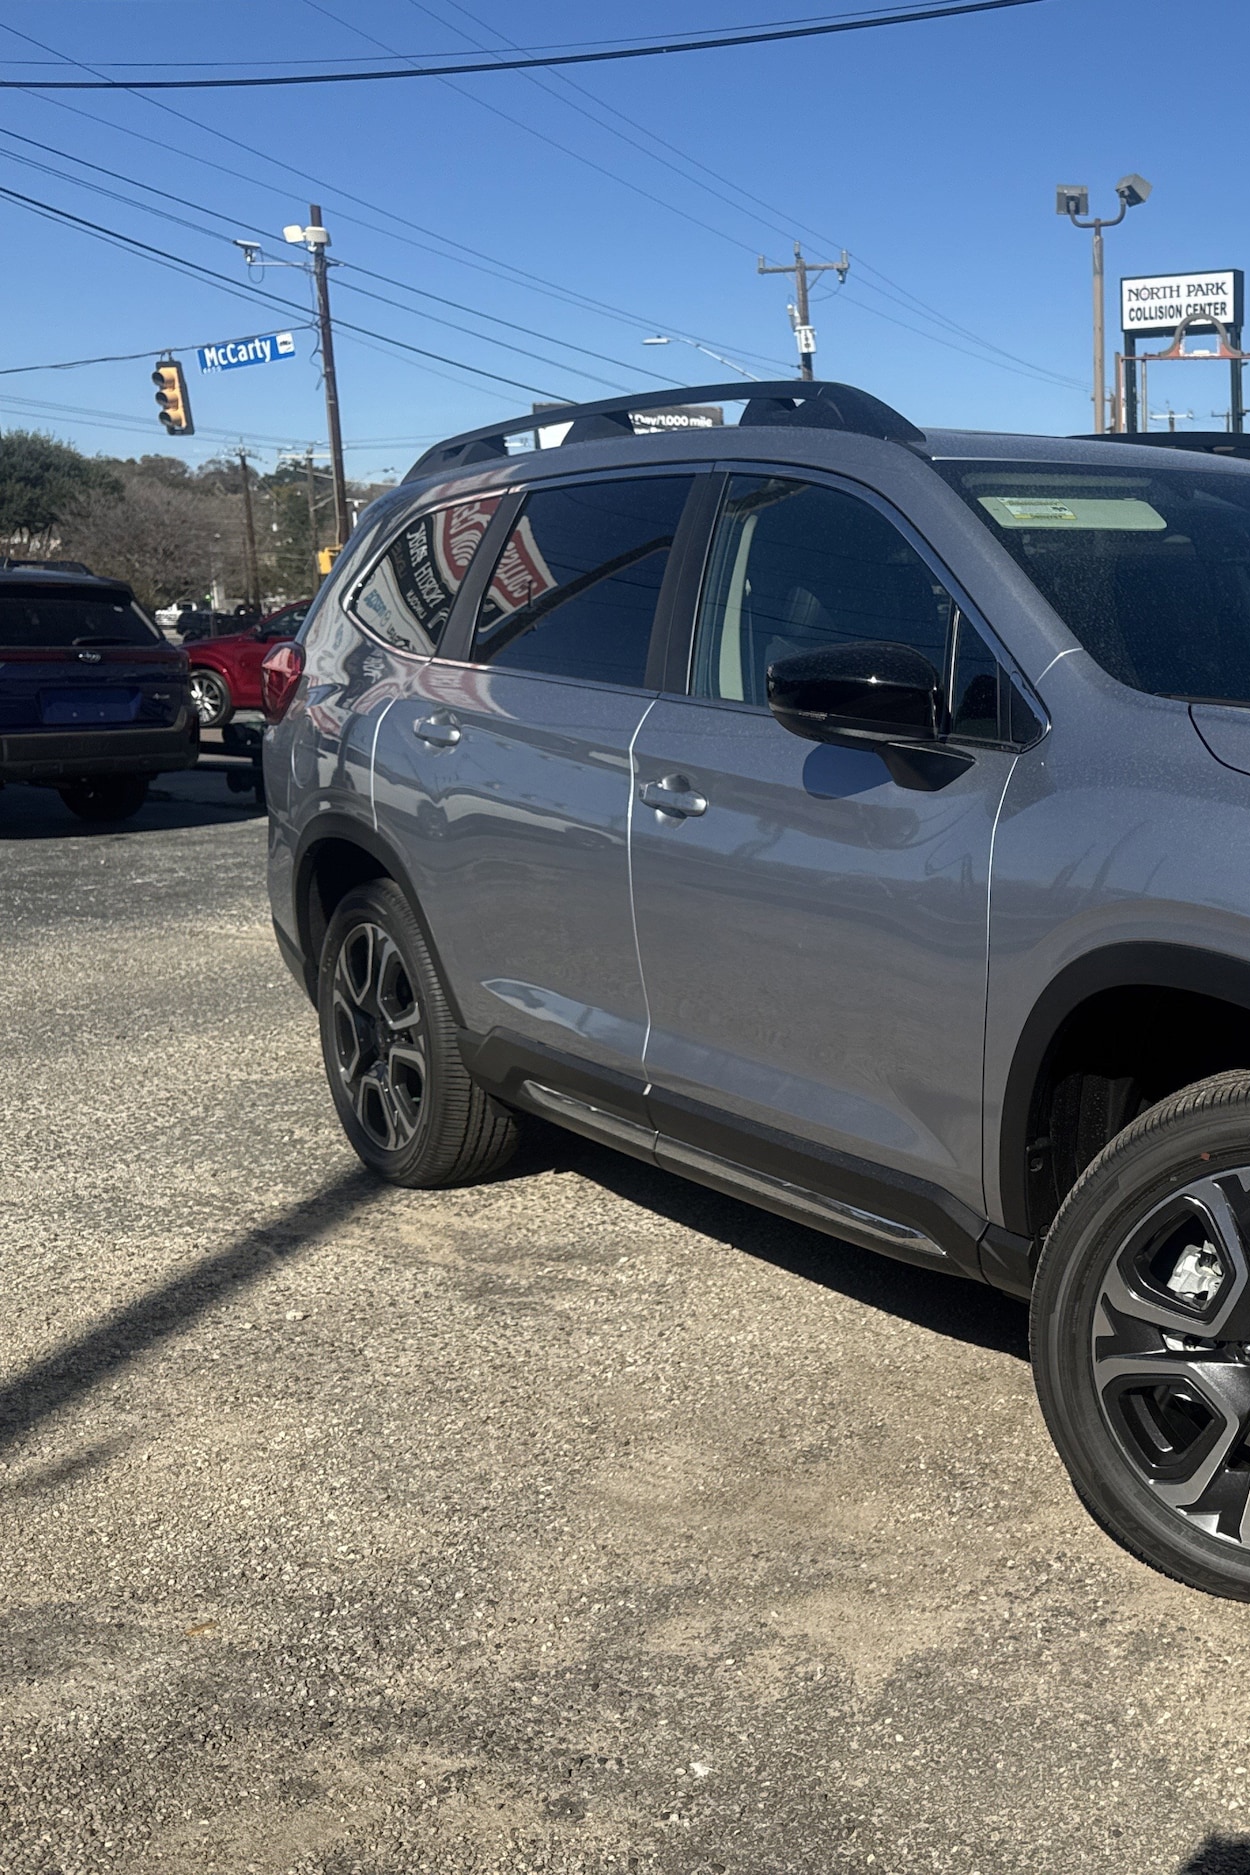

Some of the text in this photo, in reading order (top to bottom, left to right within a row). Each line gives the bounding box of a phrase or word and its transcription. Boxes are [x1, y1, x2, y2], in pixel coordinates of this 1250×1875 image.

[1127, 281, 1229, 301] NORTH PARK
[1128, 301, 1228, 322] COLLISION CENTER
[203, 338, 271, 366] McCarty
